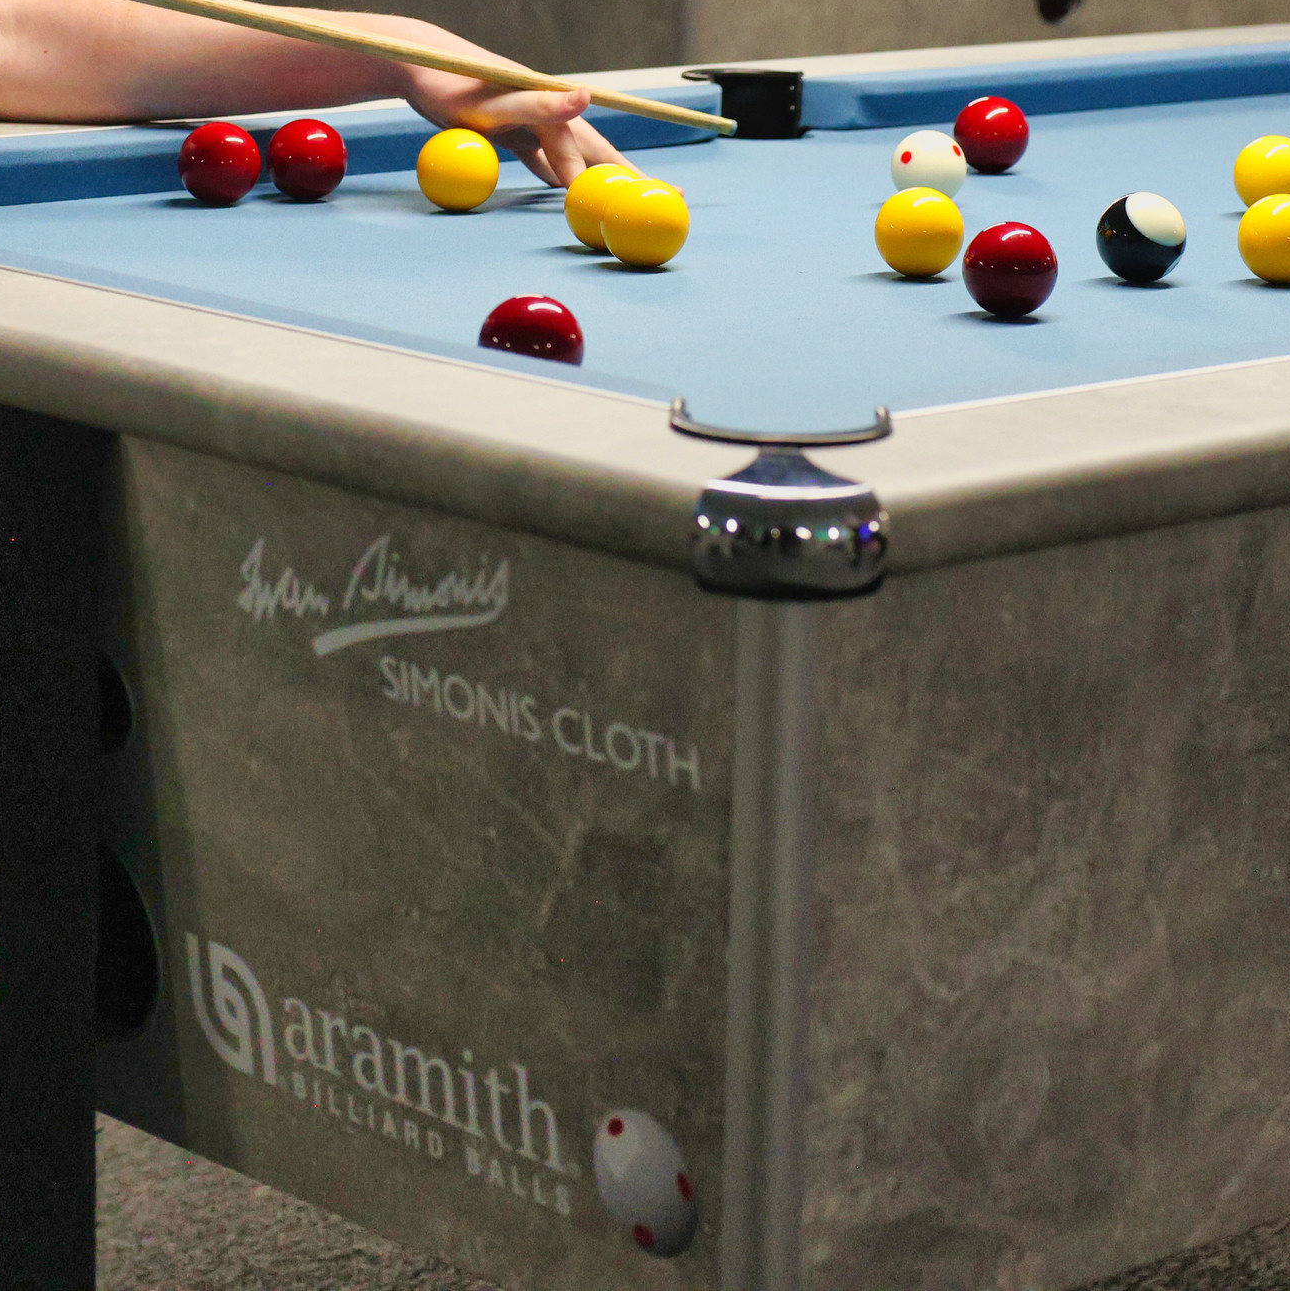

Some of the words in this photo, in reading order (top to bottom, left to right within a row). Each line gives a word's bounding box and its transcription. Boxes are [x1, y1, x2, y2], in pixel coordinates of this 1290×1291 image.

[379, 655, 541, 743] SIMONIS
[552, 707, 701, 791] CLOTH
[282, 997, 566, 1174] aramith
[291, 1071, 444, 1161] BILLIARD
[465, 1146, 572, 1217] BALLS
